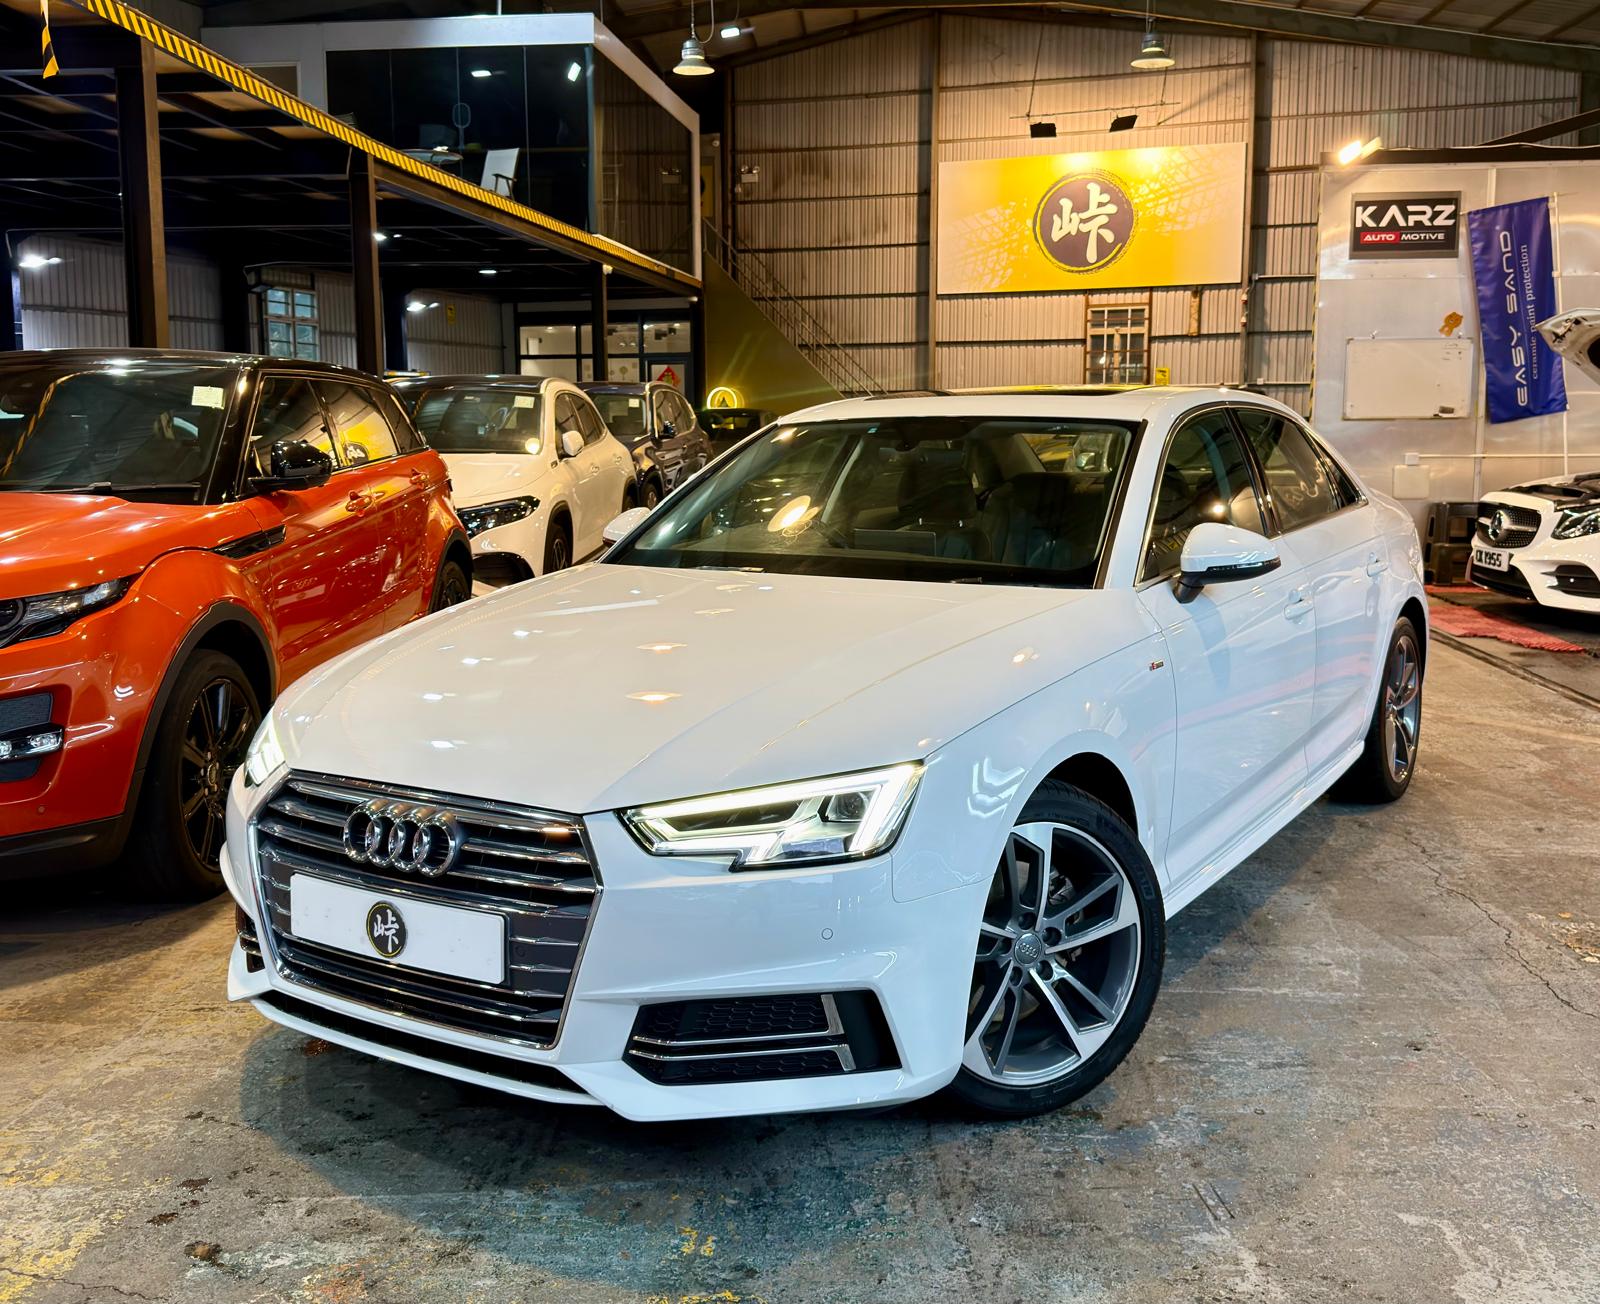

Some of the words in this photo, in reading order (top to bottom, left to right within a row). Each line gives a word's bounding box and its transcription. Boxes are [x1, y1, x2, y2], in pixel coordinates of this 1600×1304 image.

[1051, 182, 1118, 264] 峠
[1355, 204, 1456, 228] KARZ
[1363, 233, 1396, 242] AUTO
[1400, 232, 1445, 241] MOTIVE
[1499, 231, 1518, 314] SAND
[1519, 244, 1536, 302] protection
[1526, 304, 1537, 333] paint
[1508, 325, 1528, 406] EASY
[1530, 336, 1538, 380] ceramic
[373, 909, 400, 953] 峠
